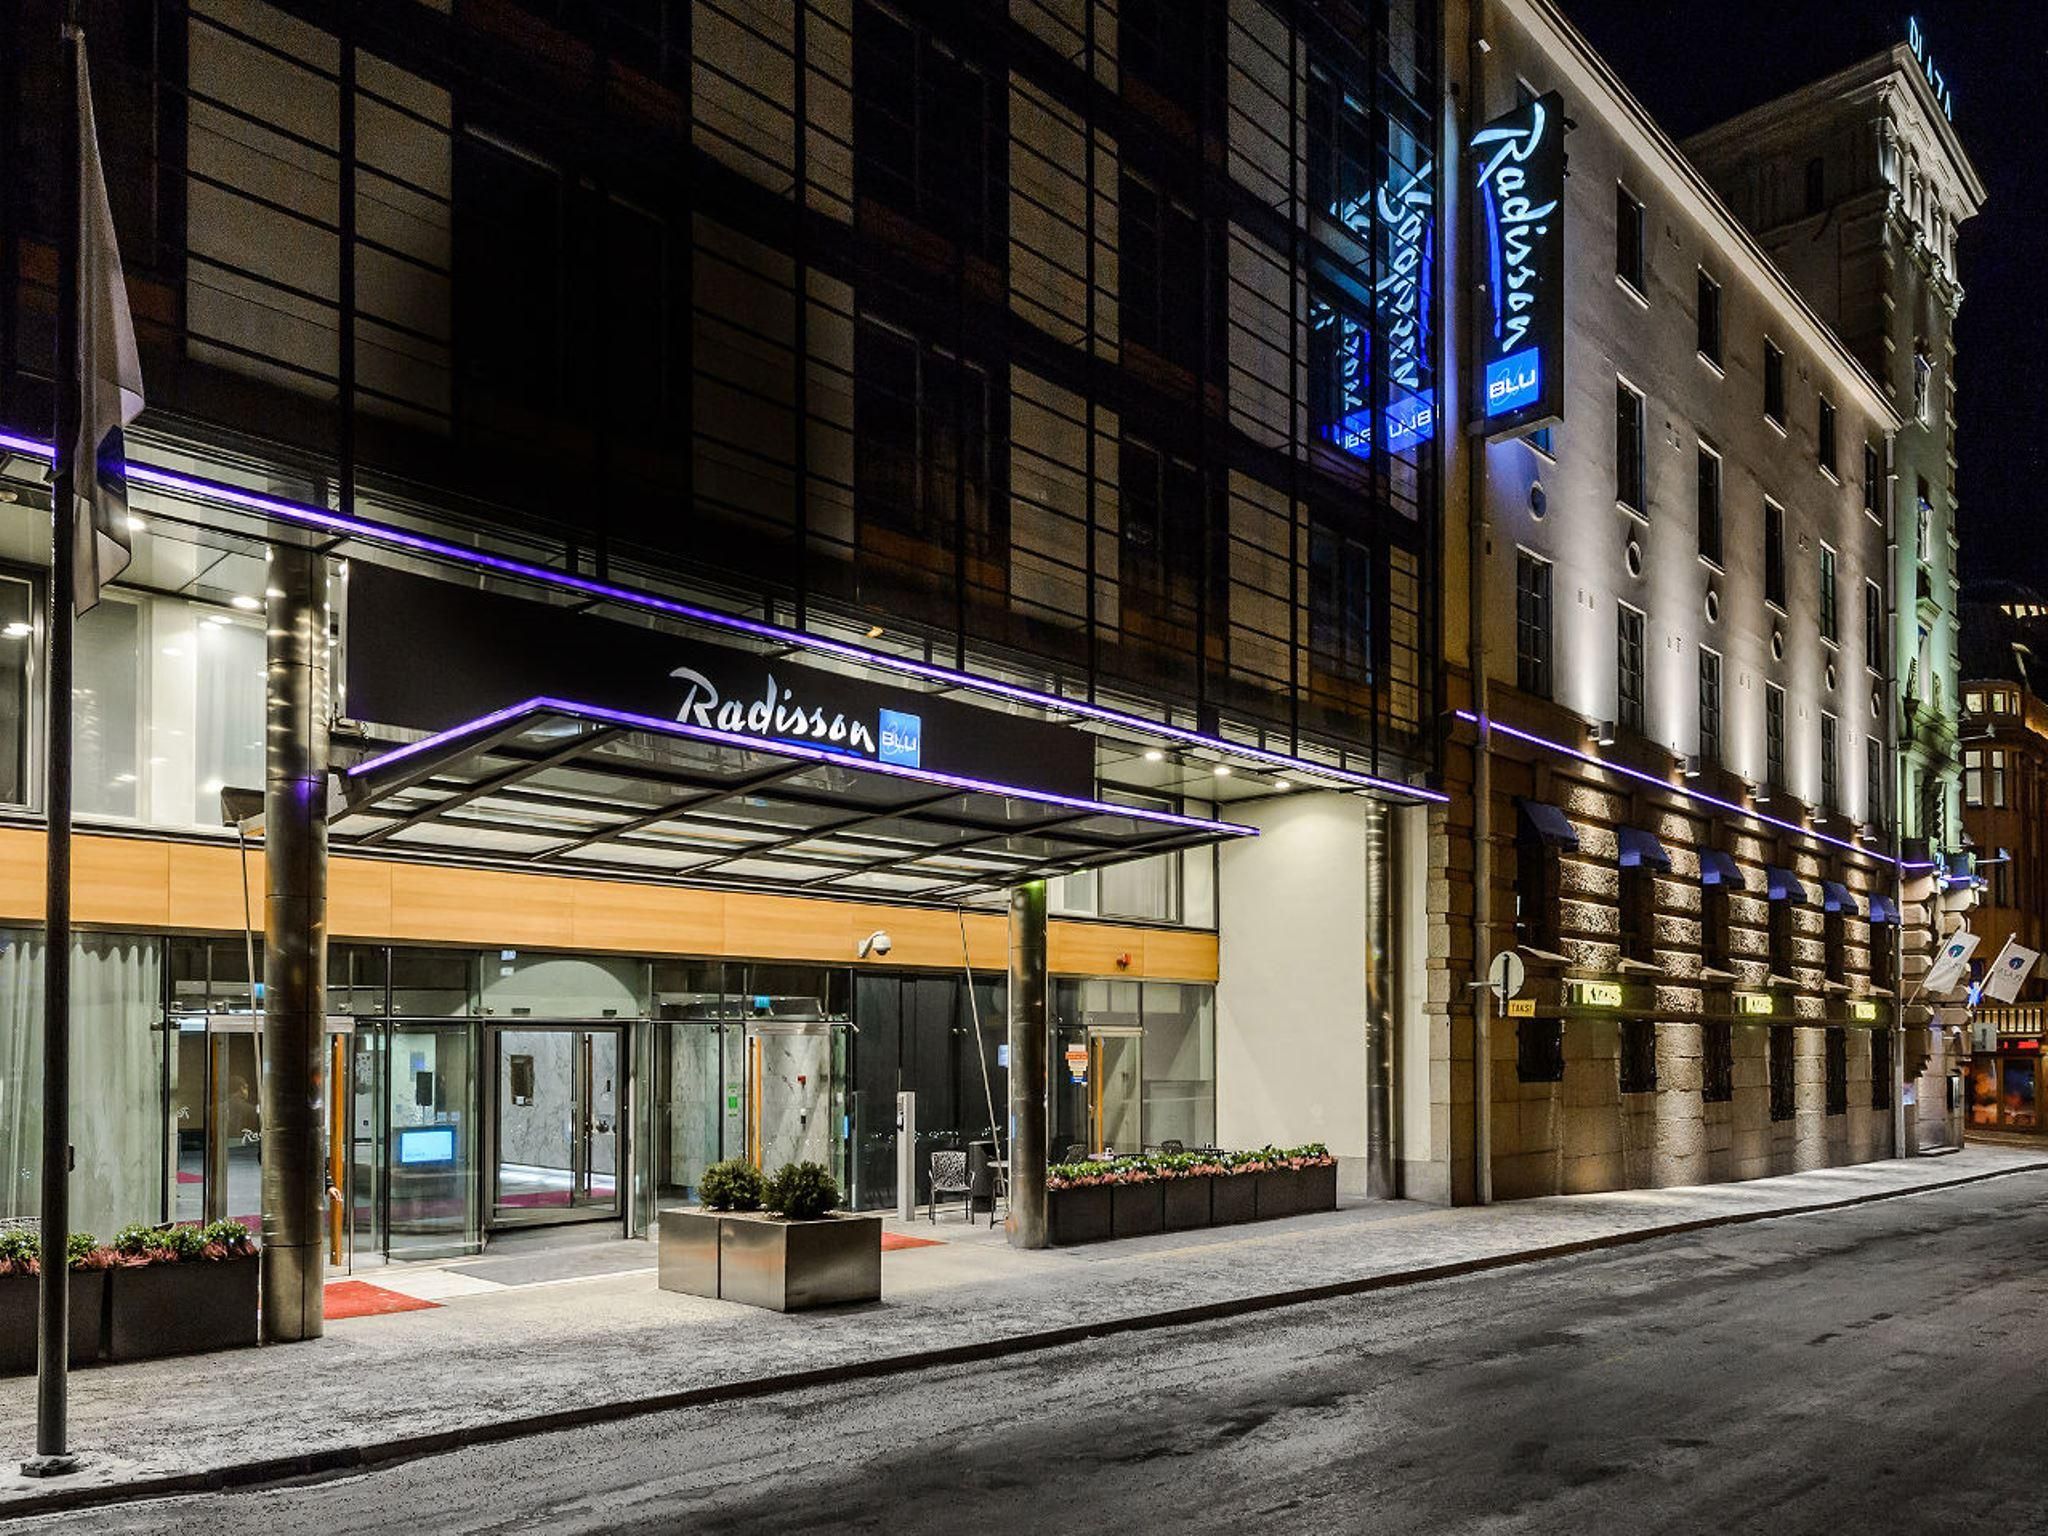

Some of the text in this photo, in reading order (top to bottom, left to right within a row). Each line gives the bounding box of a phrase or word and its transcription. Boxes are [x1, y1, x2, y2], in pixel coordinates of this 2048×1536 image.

[1470, 101, 1558, 353] Radisson
[1489, 368, 1537, 400] BLU
[669, 666, 918, 753] Radisson BLU
